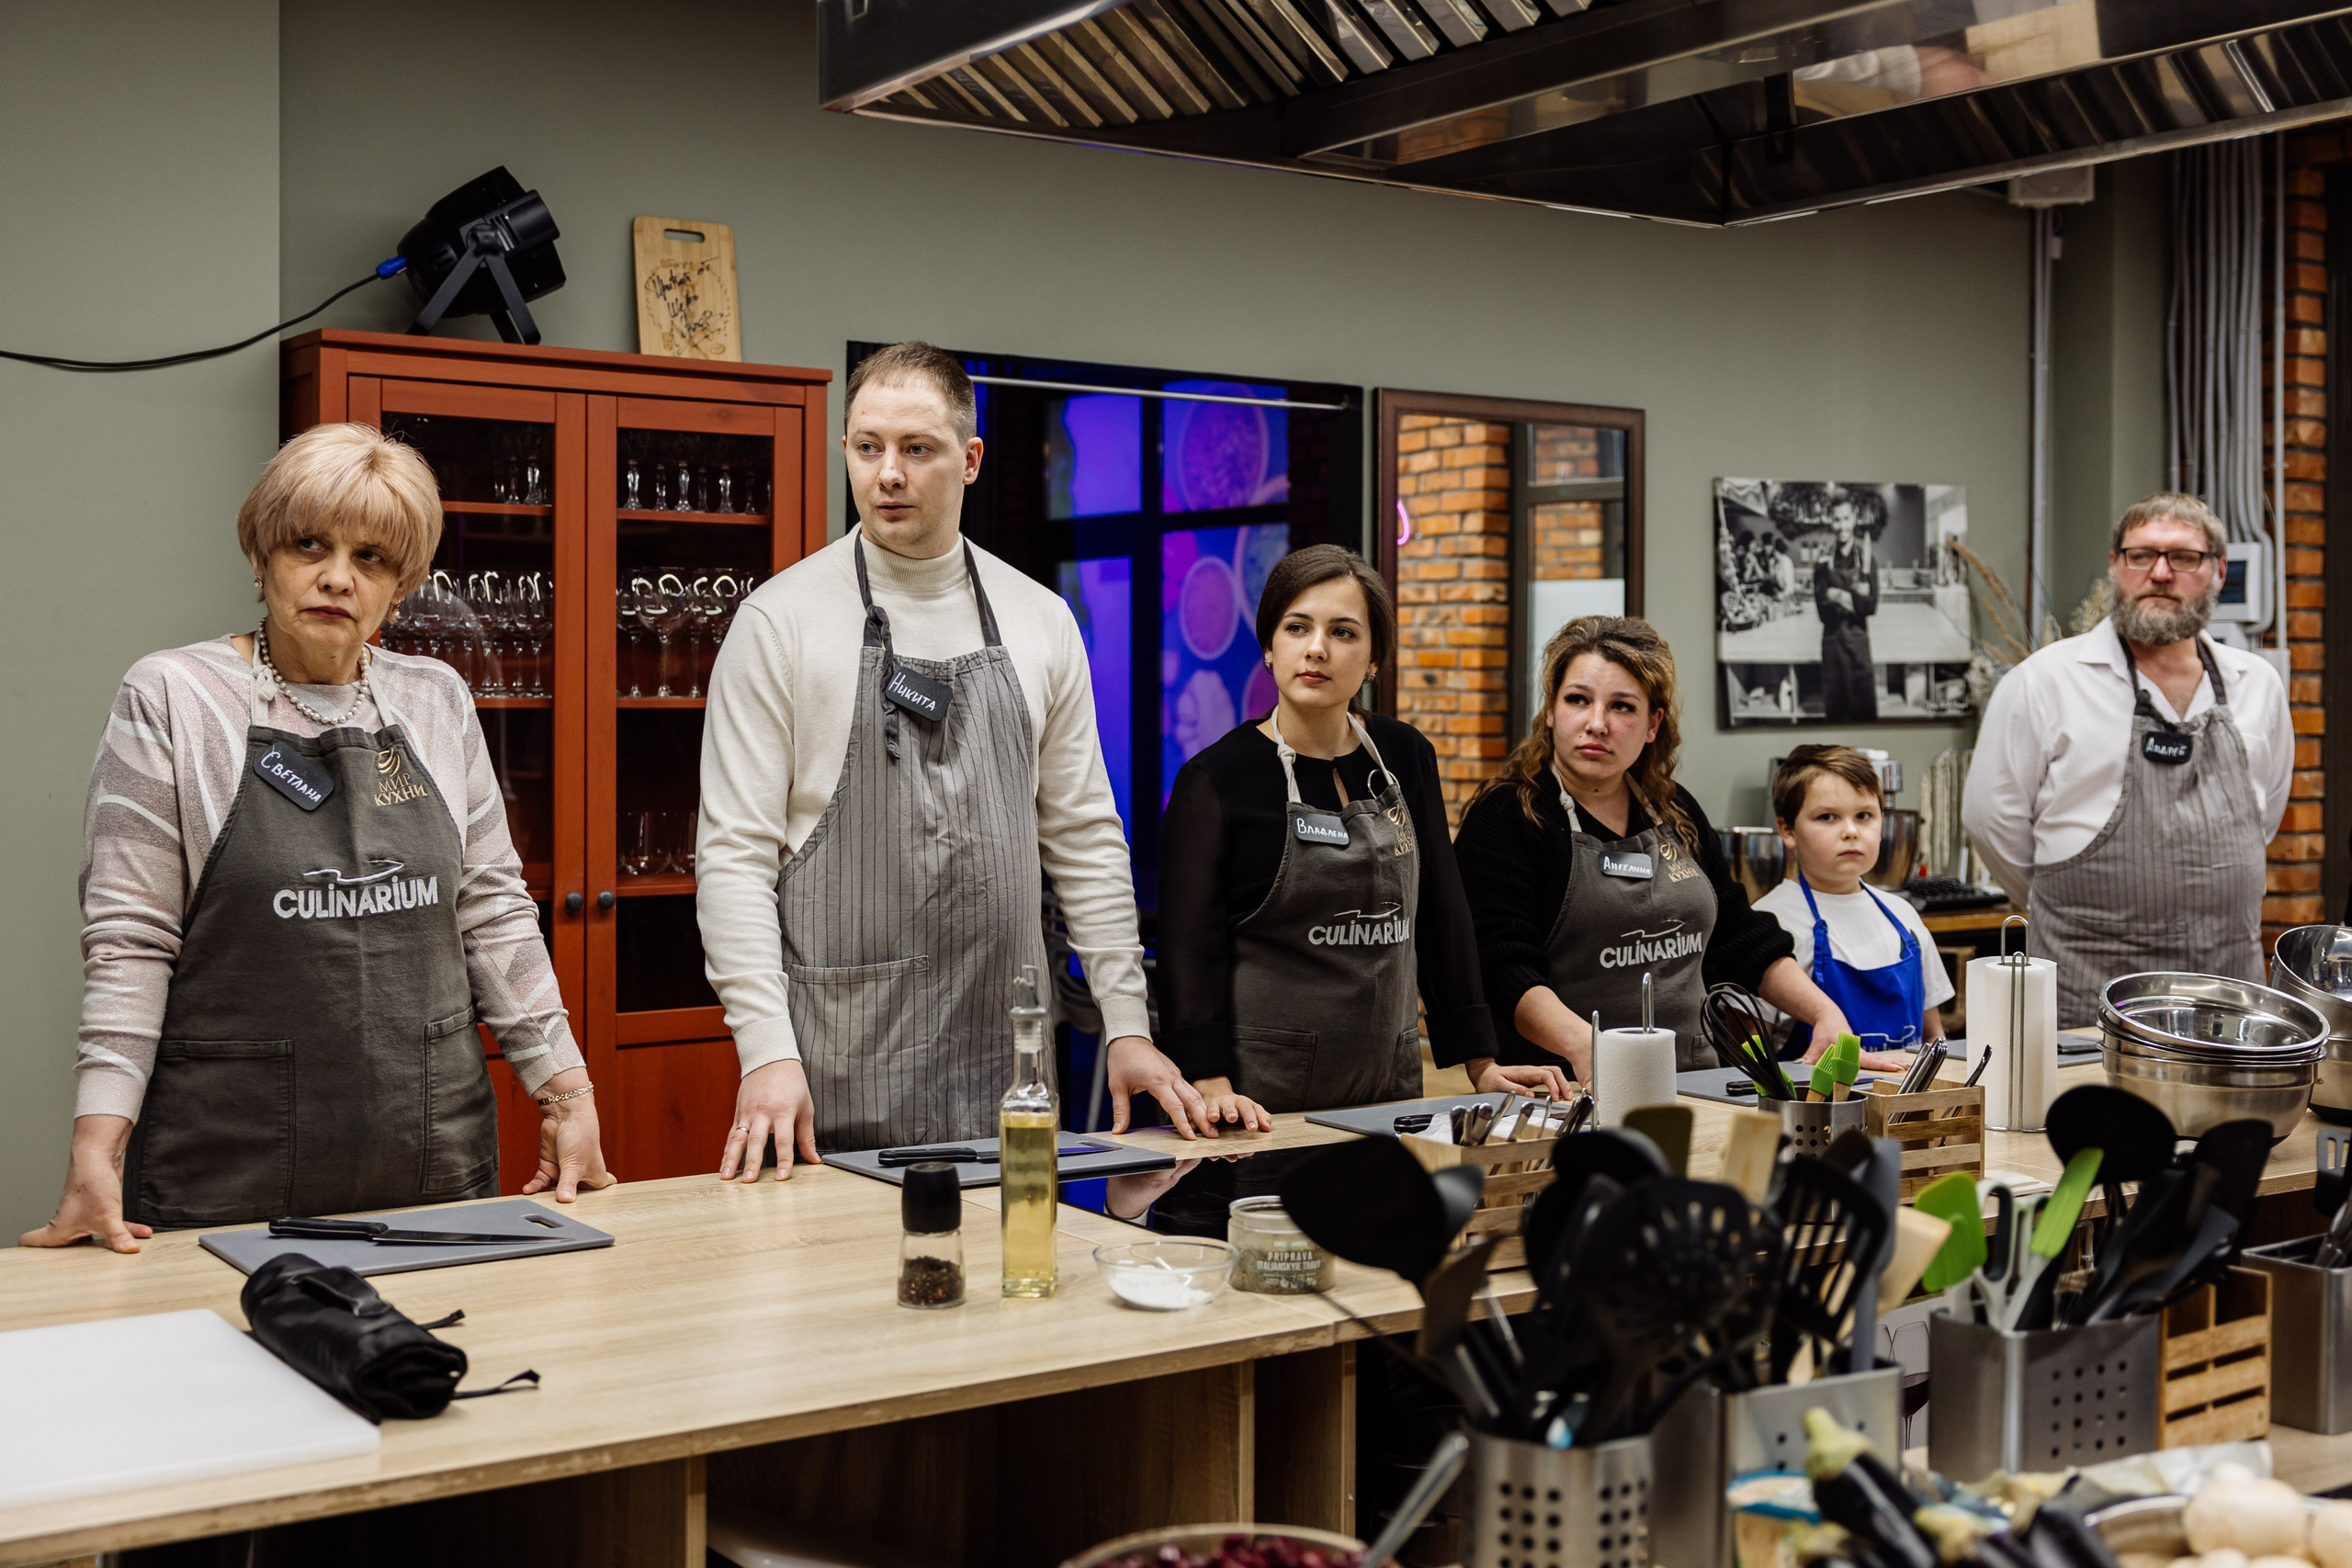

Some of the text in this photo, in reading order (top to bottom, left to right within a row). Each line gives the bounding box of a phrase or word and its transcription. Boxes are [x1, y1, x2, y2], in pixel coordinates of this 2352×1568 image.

[379, 773, 411, 793] МИР
[374, 784, 428, 807] КУХНИ
[1268, 1251, 1313, 1261] PRIPRAVA
